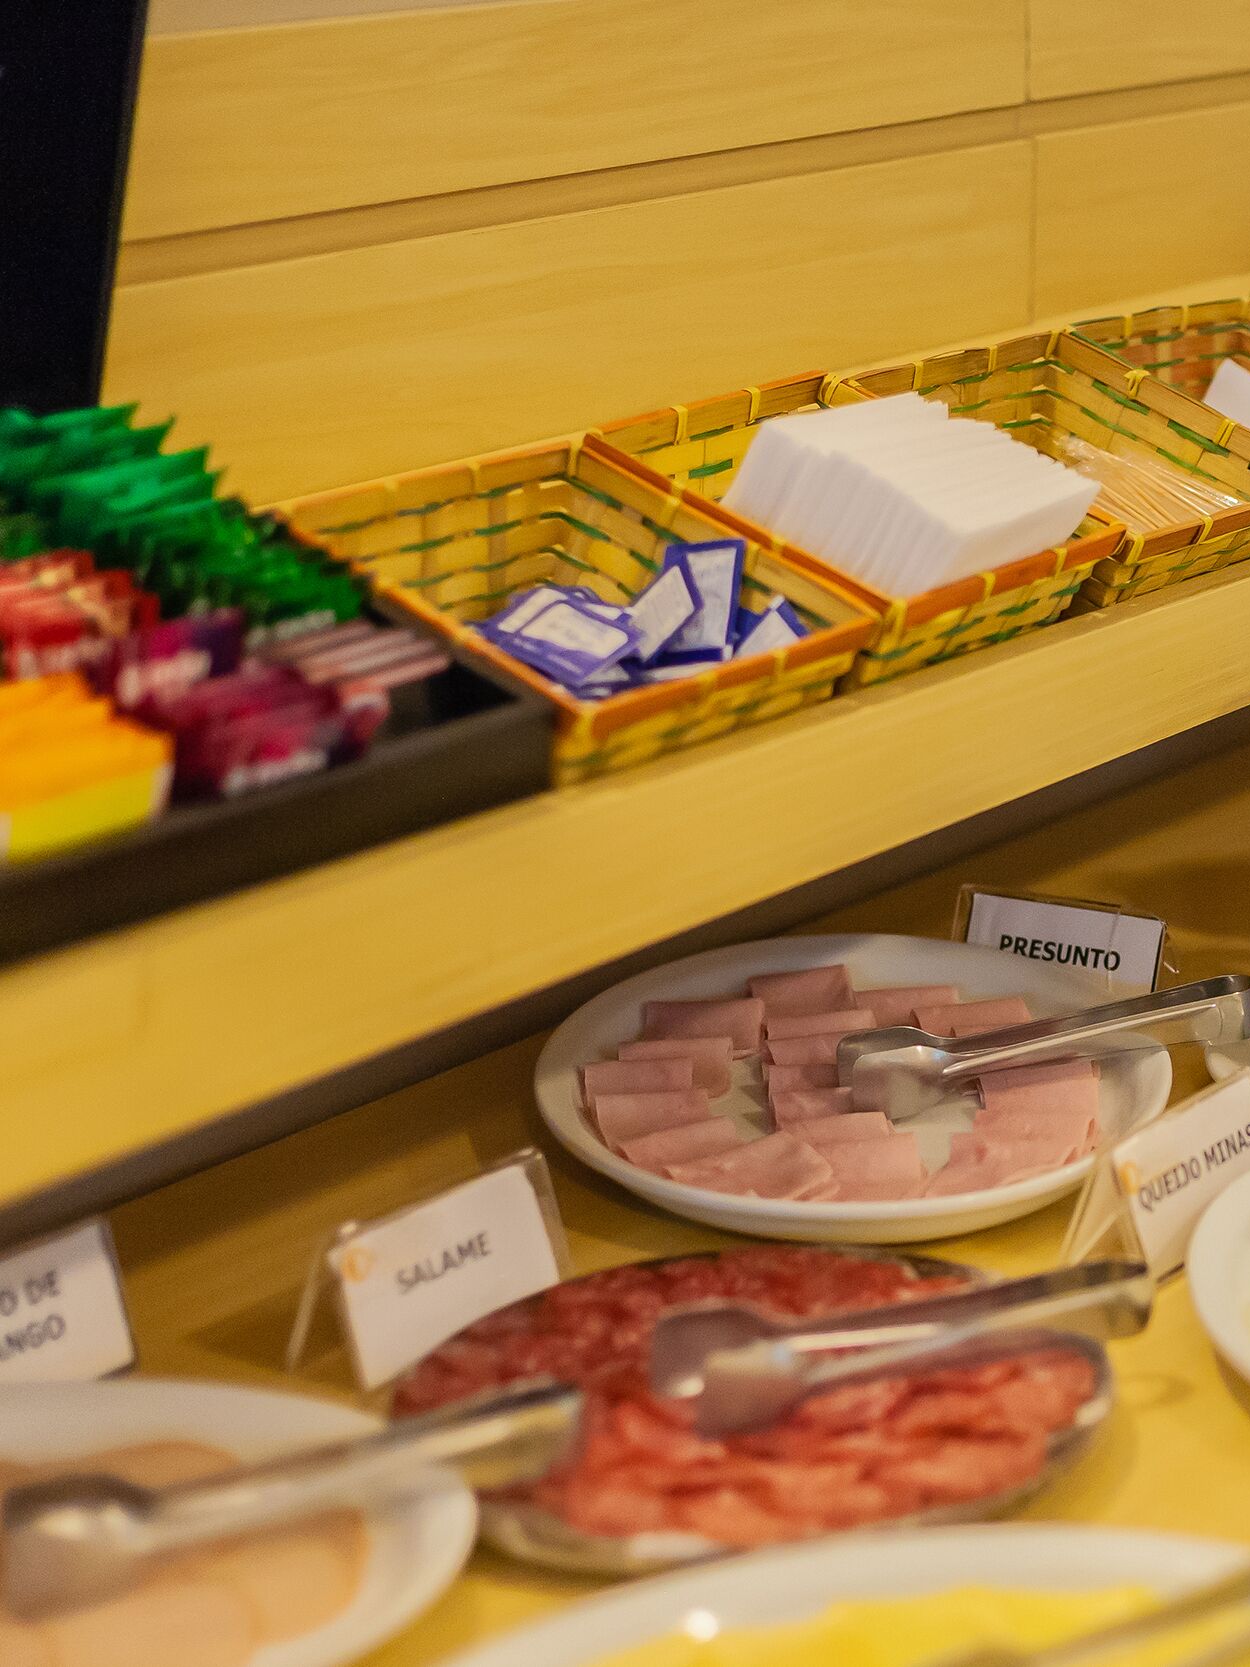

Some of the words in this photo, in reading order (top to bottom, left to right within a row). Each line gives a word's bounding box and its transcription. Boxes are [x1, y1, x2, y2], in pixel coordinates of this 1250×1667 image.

[1000, 934, 1121, 972] PRESUNTO
[1138, 1157, 1201, 1213] QUEIJO
[397, 1231, 490, 1296] SALAME
[24, 1270, 62, 1306] DE
